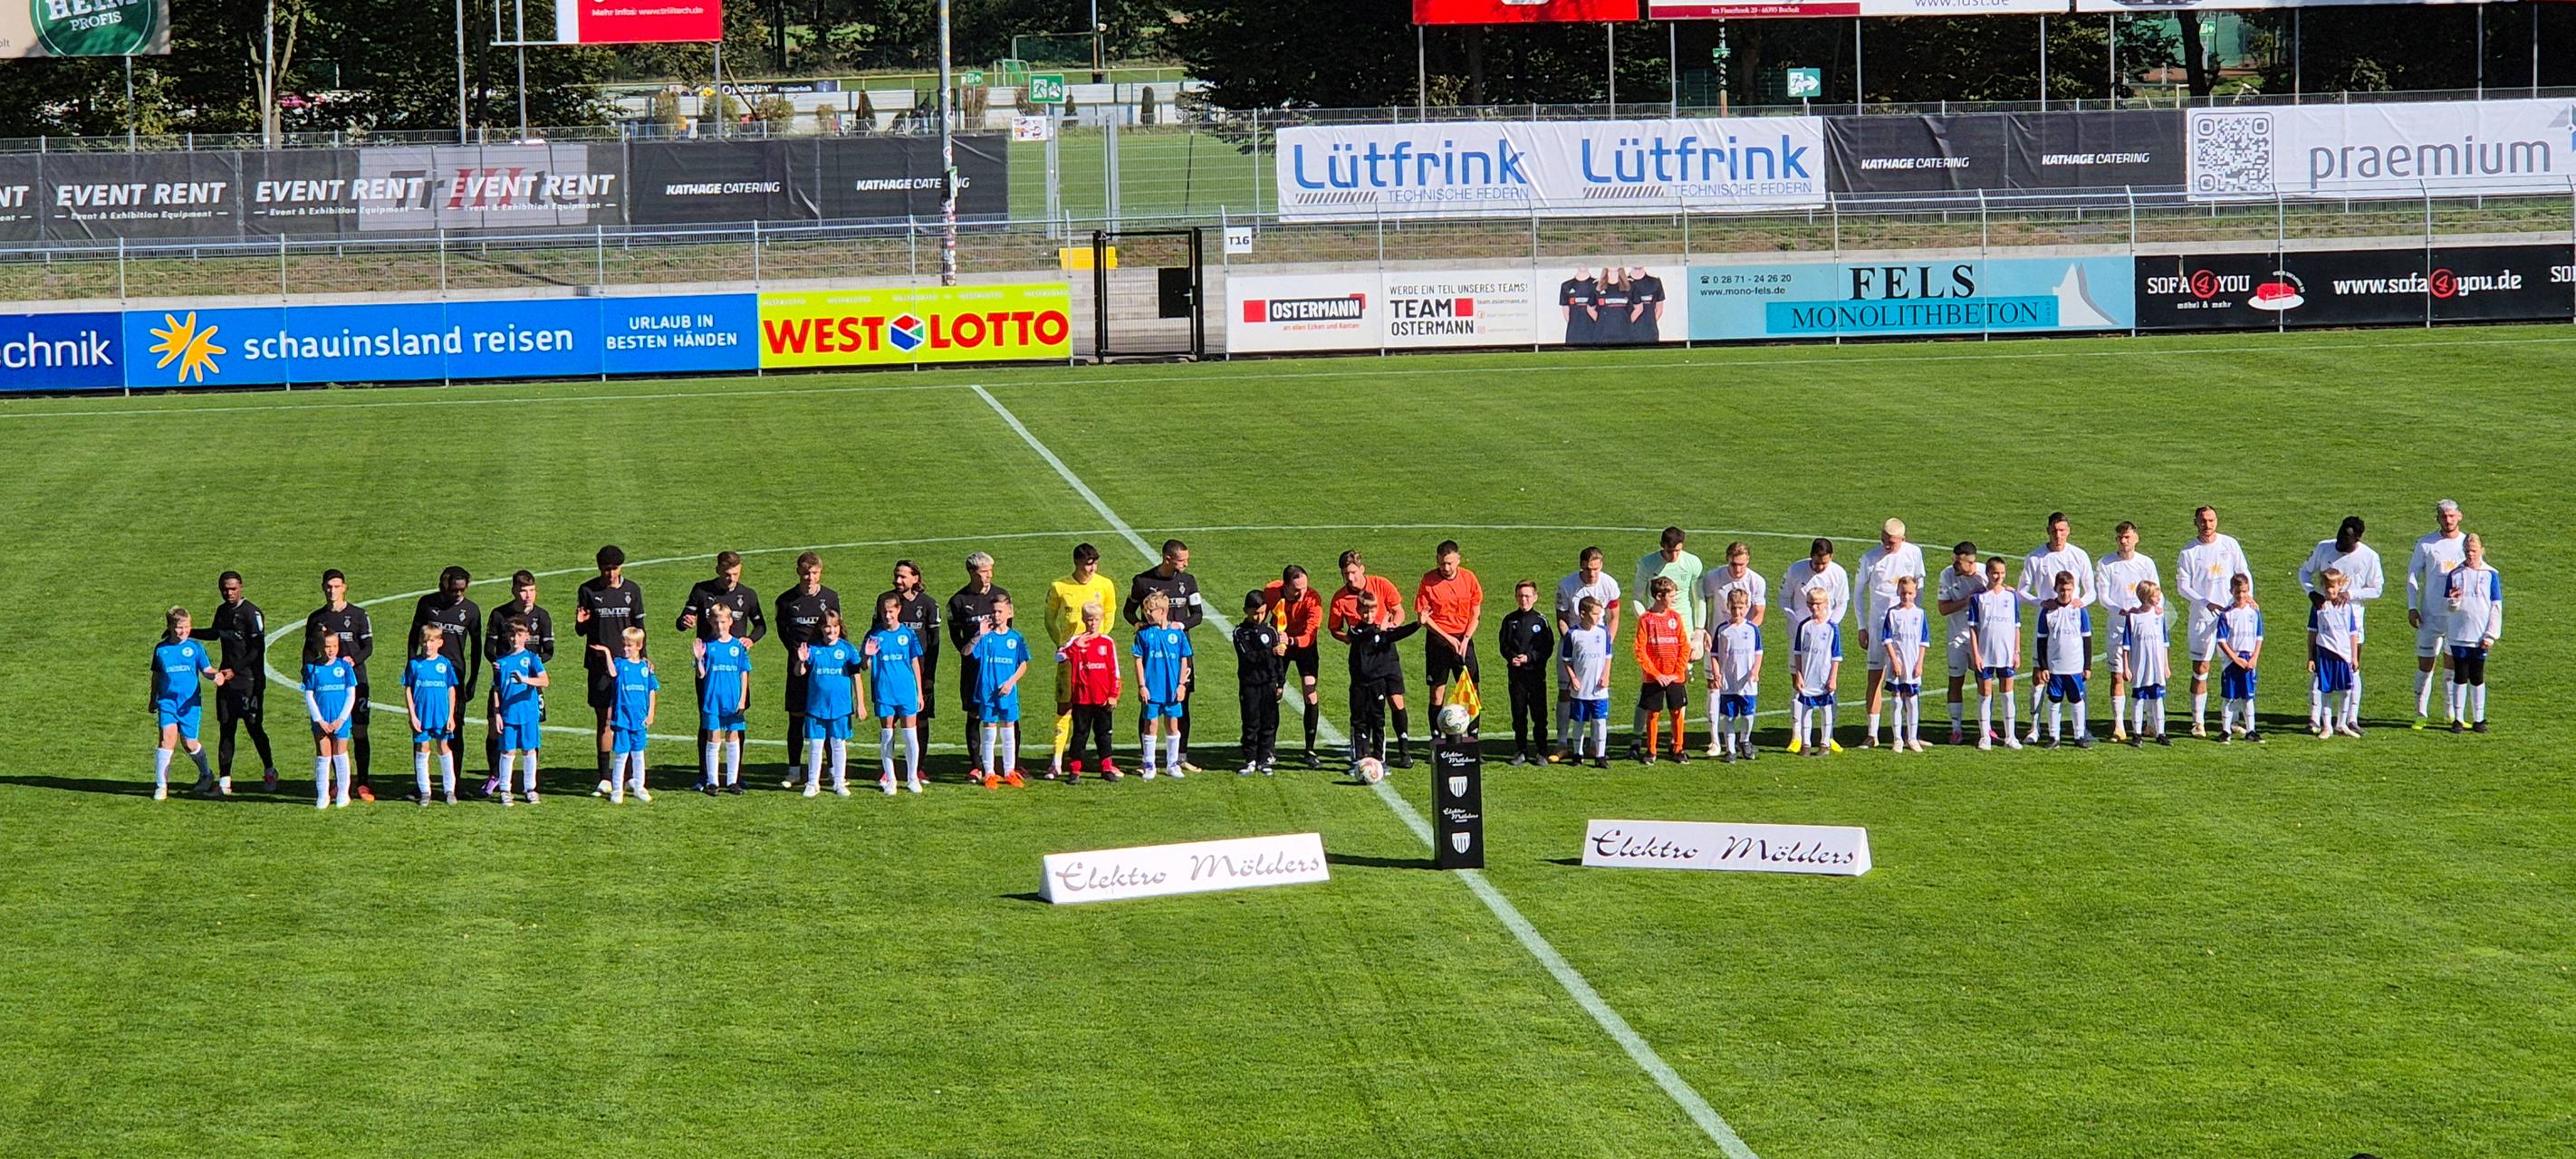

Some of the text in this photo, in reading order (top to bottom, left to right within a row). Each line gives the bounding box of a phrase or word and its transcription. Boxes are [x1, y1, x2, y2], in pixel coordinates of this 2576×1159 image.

[70, 11, 122, 32] PROFIS
[1293, 139, 1528, 190] Lütfrink
[1582, 135, 1810, 184] Lütfrink
[1861, 157, 1970, 169] KATHAGE CATERING
[2042, 153, 2150, 165] KATHAGE CATERING
[2310, 135, 2551, 190] praemium
[57, 182, 226, 206] EVENT RENT
[255, 177, 423, 202] EVENT RENT
[449, 175, 616, 198] EVENT RENT
[666, 181, 781, 196] KATHAGE CATERING
[855, 177, 971, 191] KATHAGE CATENG
[1673, 182, 1812, 197] TECHNISCHE FEDERN
[1388, 187, 1530, 203] TECHNISCHE FEDERN
[72, 212, 97, 220] Event
[110, 211, 159, 220] Exhibition
[161, 209, 212, 220] Equipment
[269, 207, 296, 216] Event
[309, 206, 357, 216] Exhibition
[360, 206, 409, 215] Equipment
[465, 204, 488, 212] Event
[502, 202, 548, 211] Exhibition
[552, 201, 601, 211] Equipment
[1228, 235, 1250, 245] T16
[1720, 275, 1731, 283] 28
[1754, 274, 1764, 283] 24
[1767, 274, 1778, 283] 26
[1849, 264, 1975, 301] FELS
[2333, 269, 2522, 297] www.sofa4you.de
[1389, 283, 1528, 295] WERDE EIN TEIL UNSERES TEAMS!
[1700, 285, 1785, 297] www.mono-fels.de
[1272, 300, 1360, 321] OSTERMANN
[1390, 299, 1452, 318] TEAM
[1792, 302, 2040, 330] MONOLITHBETON
[629, 314, 714, 330] URLAUB IN
[1391, 320, 1474, 336] OSTERMANN
[244, 324, 574, 360] schauinsland reisen
[606, 330, 737, 350] BESTEN HÄNDEN
[763, 310, 1070, 355] WEST LOTTO
[0, 330, 114, 369] chnik
[1591, 829, 1854, 864] Elektro Mölders
[1055, 851, 1320, 892] Elektro Mölders
